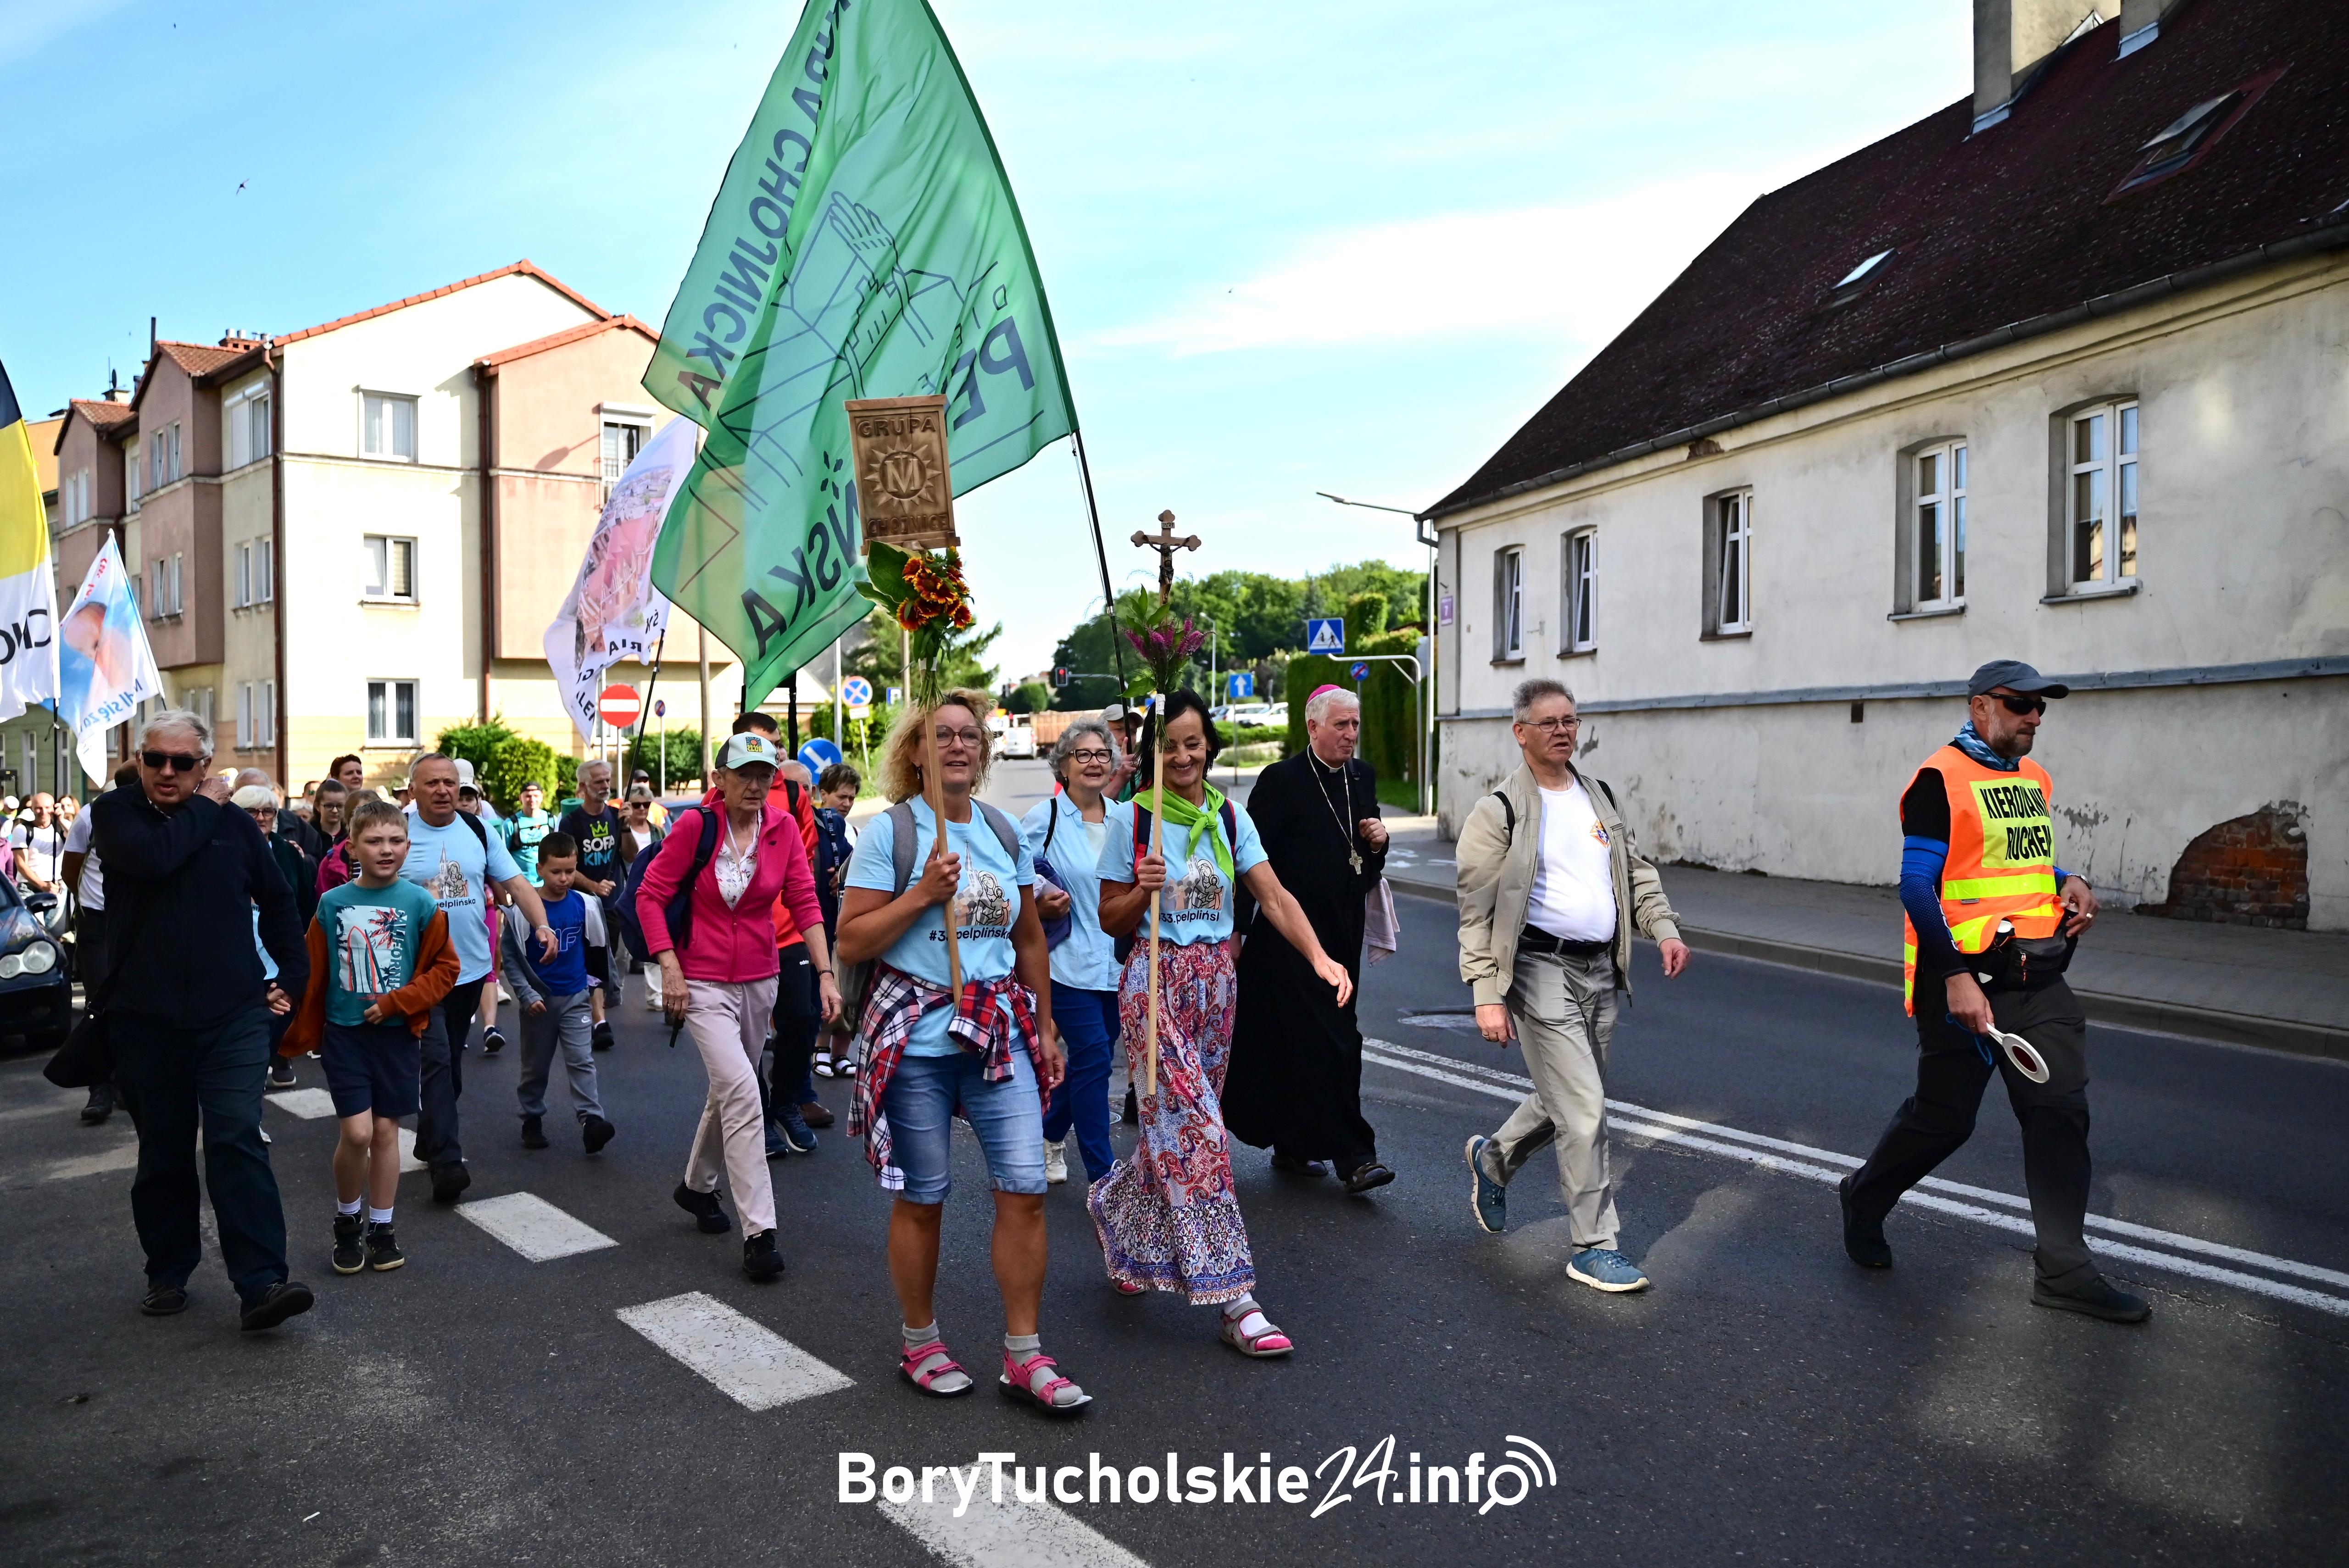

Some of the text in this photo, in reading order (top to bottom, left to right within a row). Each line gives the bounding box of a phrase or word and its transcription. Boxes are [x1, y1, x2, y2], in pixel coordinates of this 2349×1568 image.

[857, 417, 936, 437] GRUPA
[867, 513, 948, 535] CHOJNICE
[583, 834, 615, 853] SOFA
